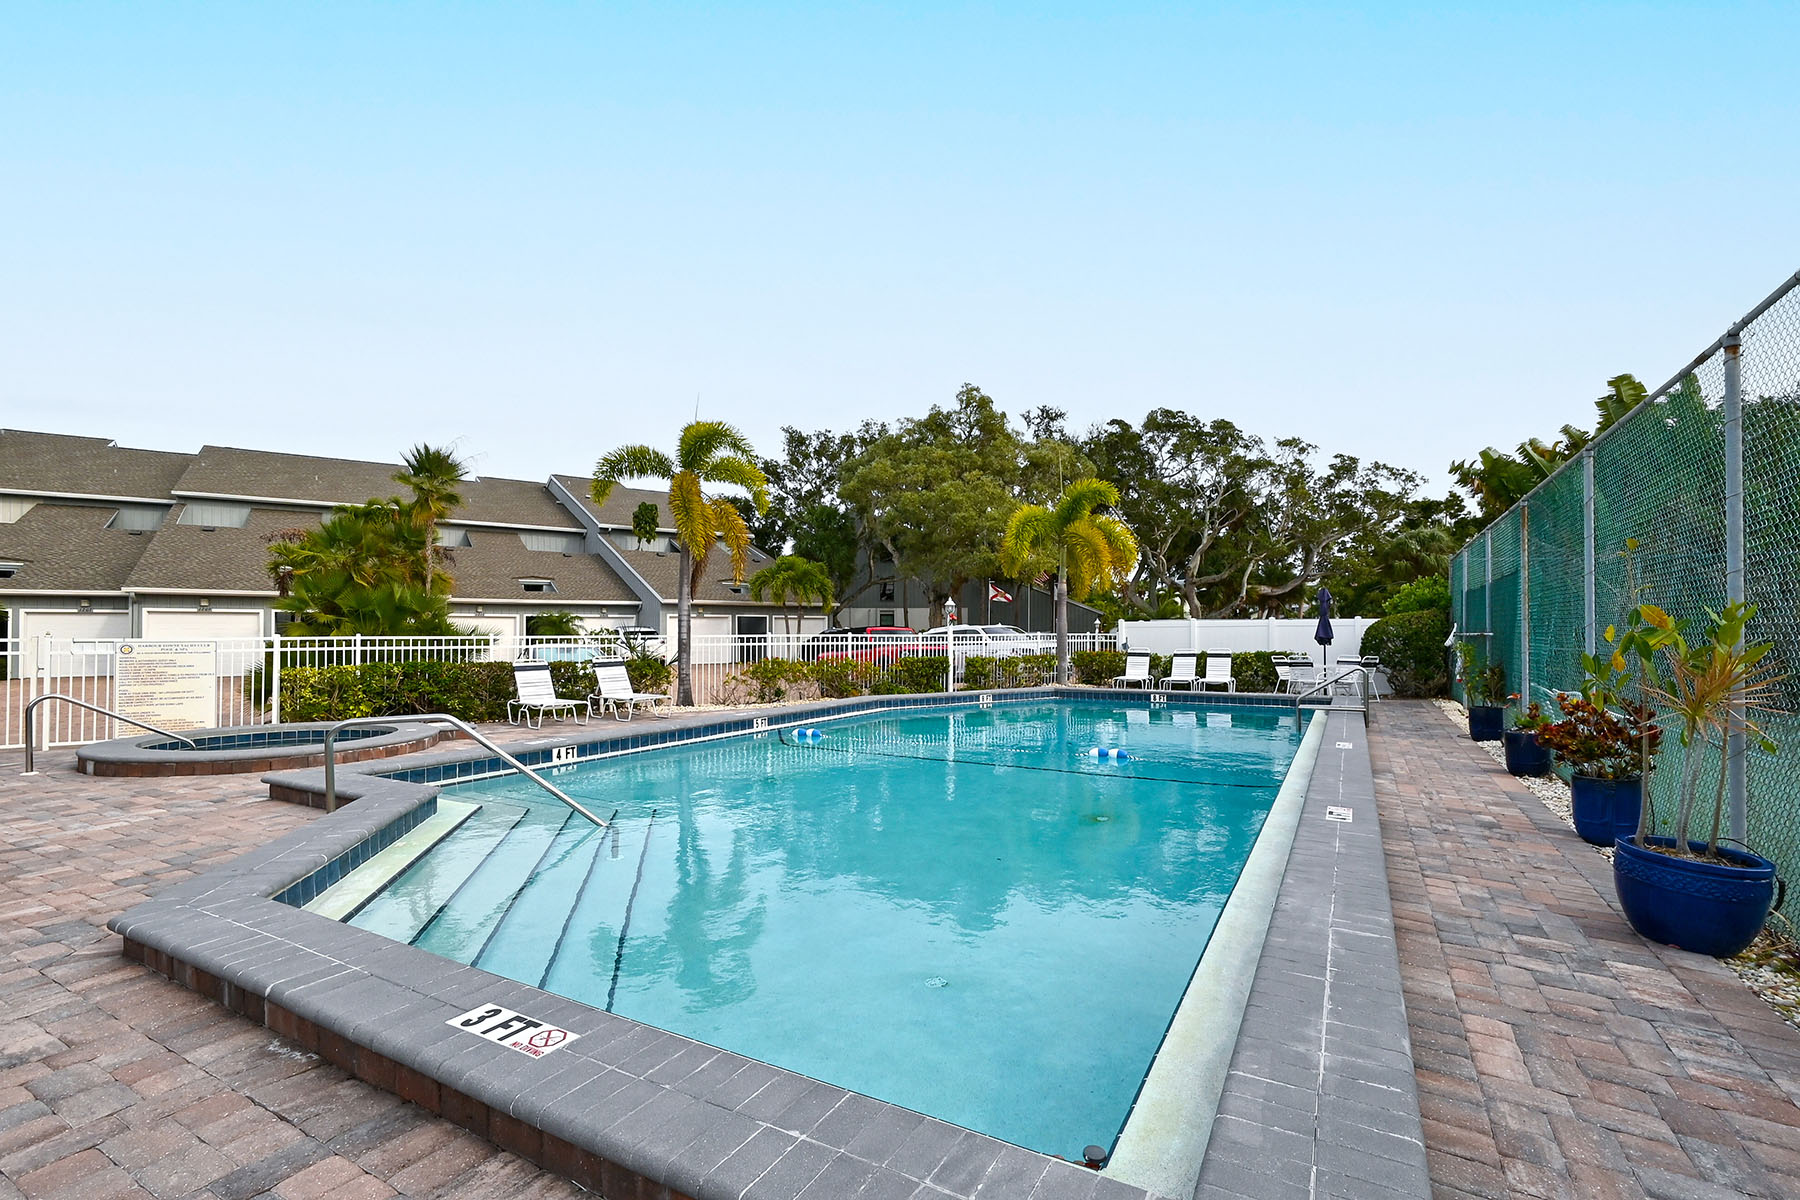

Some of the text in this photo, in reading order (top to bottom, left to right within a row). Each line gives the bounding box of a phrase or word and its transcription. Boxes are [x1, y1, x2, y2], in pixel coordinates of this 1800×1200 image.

[756, 718, 767, 728] 5 FT
[556, 746, 576, 760] 4 FT
[460, 1008, 544, 1042] 3 FT
[518, 1044, 545, 1058] DIVING
